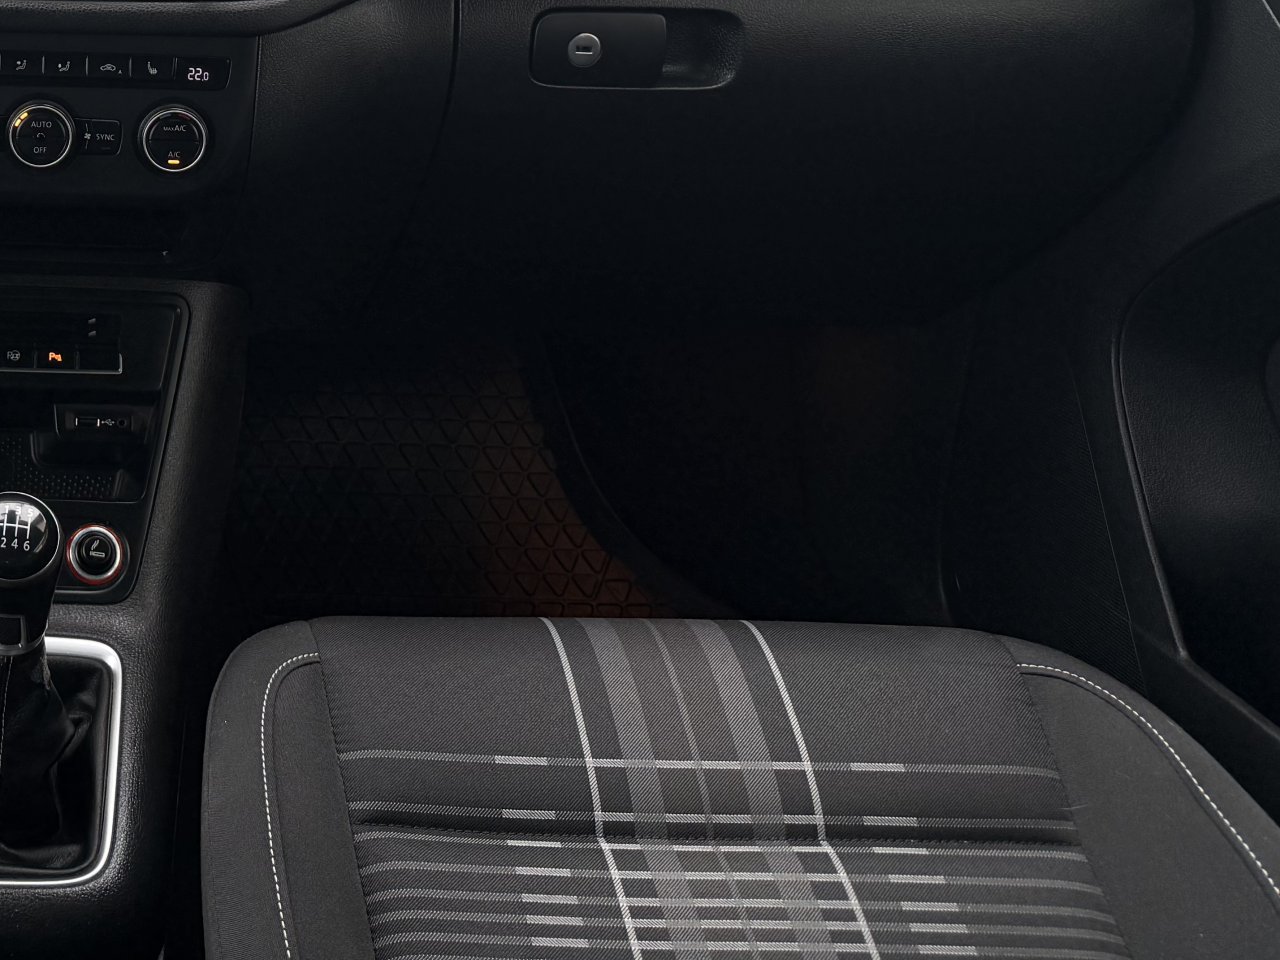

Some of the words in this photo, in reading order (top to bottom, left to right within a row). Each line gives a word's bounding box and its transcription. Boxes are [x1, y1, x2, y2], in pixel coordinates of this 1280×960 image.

[187, 67, 209, 82] 22.0
[31, 120, 52, 129] AUTO
[96, 133, 116, 141] SYNC
[33, 145, 48, 154] OFF
[168, 151, 181, 159] A/C
[0, 537, 7, 548] 2
[11, 538, 18, 549] 4
[23, 540, 30, 551] 6
